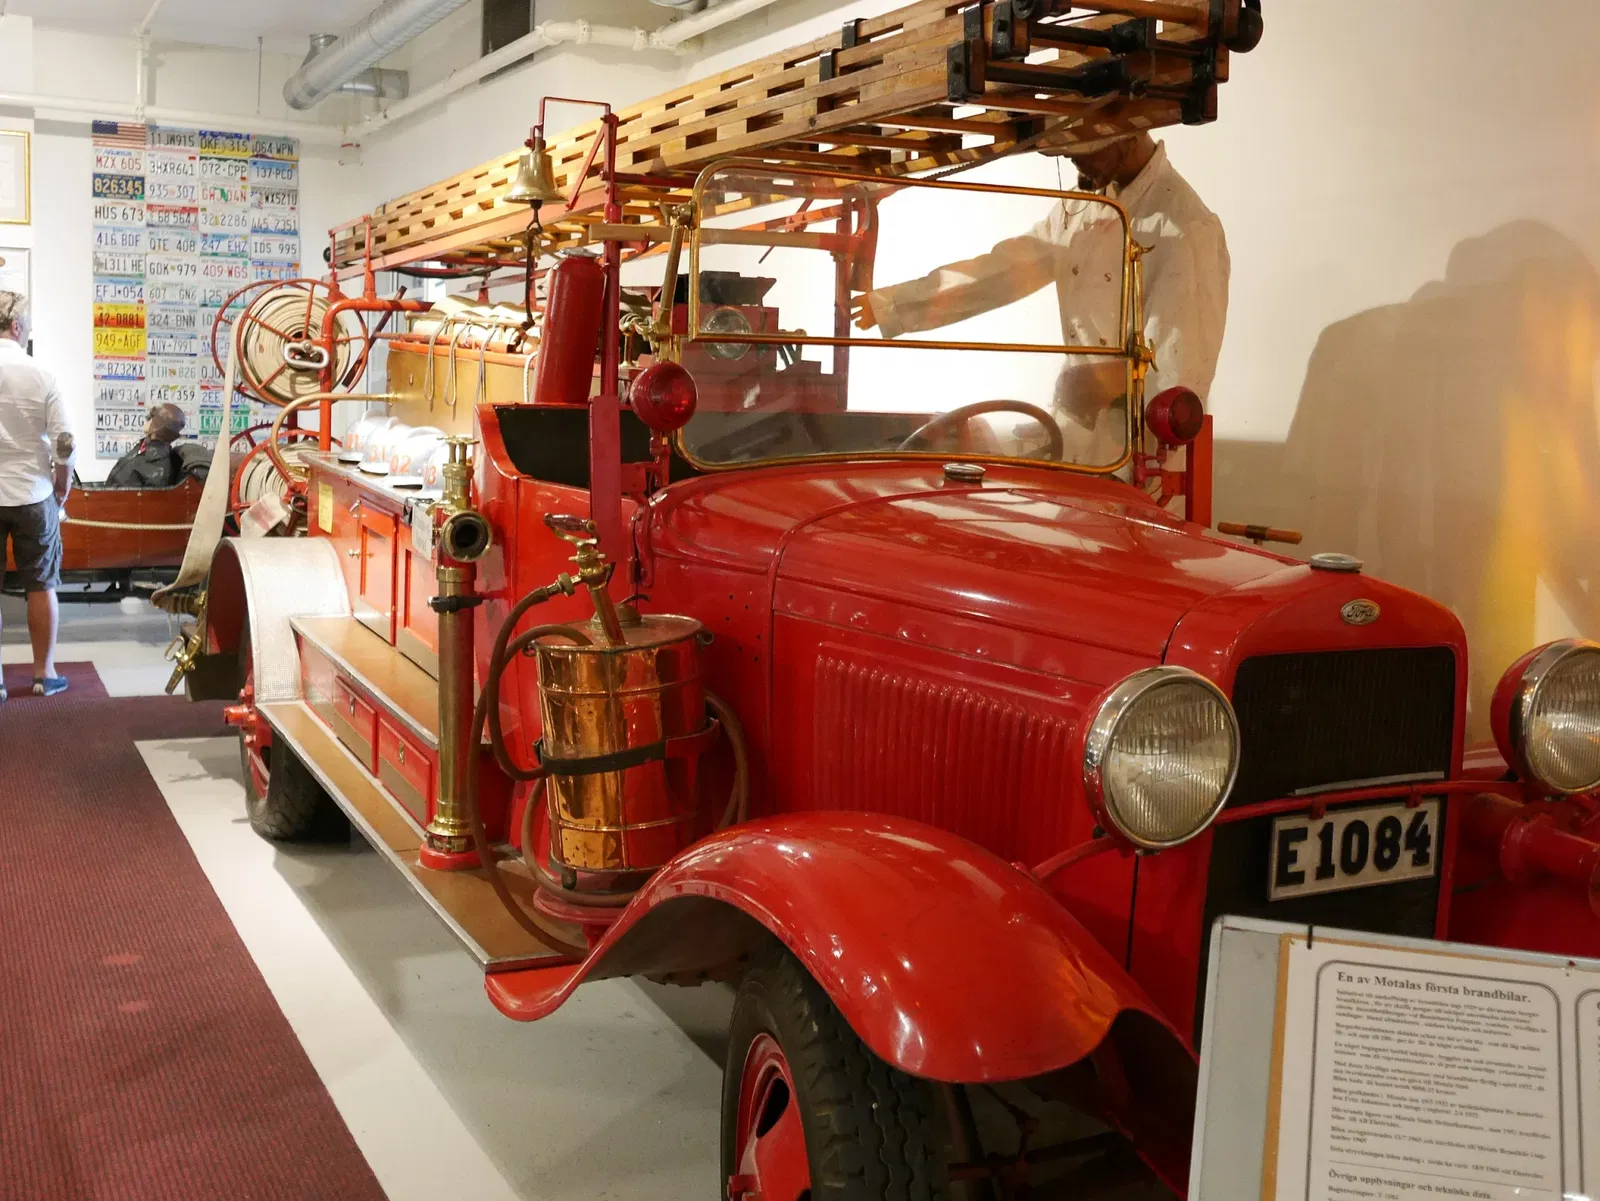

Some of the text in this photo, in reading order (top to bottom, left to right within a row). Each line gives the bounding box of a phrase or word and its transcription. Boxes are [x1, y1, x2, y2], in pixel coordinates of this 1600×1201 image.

[96, 155, 142, 170] MZX 605
[94, 178, 142, 194] 826345
[150, 185, 194, 200] 935 307
[95, 206, 144, 221] HUS 673
[97, 232, 116, 246] 416
[176, 239, 195, 252] 408
[279, 243, 297, 255] 995
[177, 265, 196, 276] 979
[150, 314, 169, 326] 324
[177, 389, 195, 401] 359
[1275, 810, 1432, 888] E1084
[1338, 971, 1531, 1003] En av Motalas första brandbilar.
[1328, 1168, 1491, 1199] Övriga upplysningar och tekniska data
